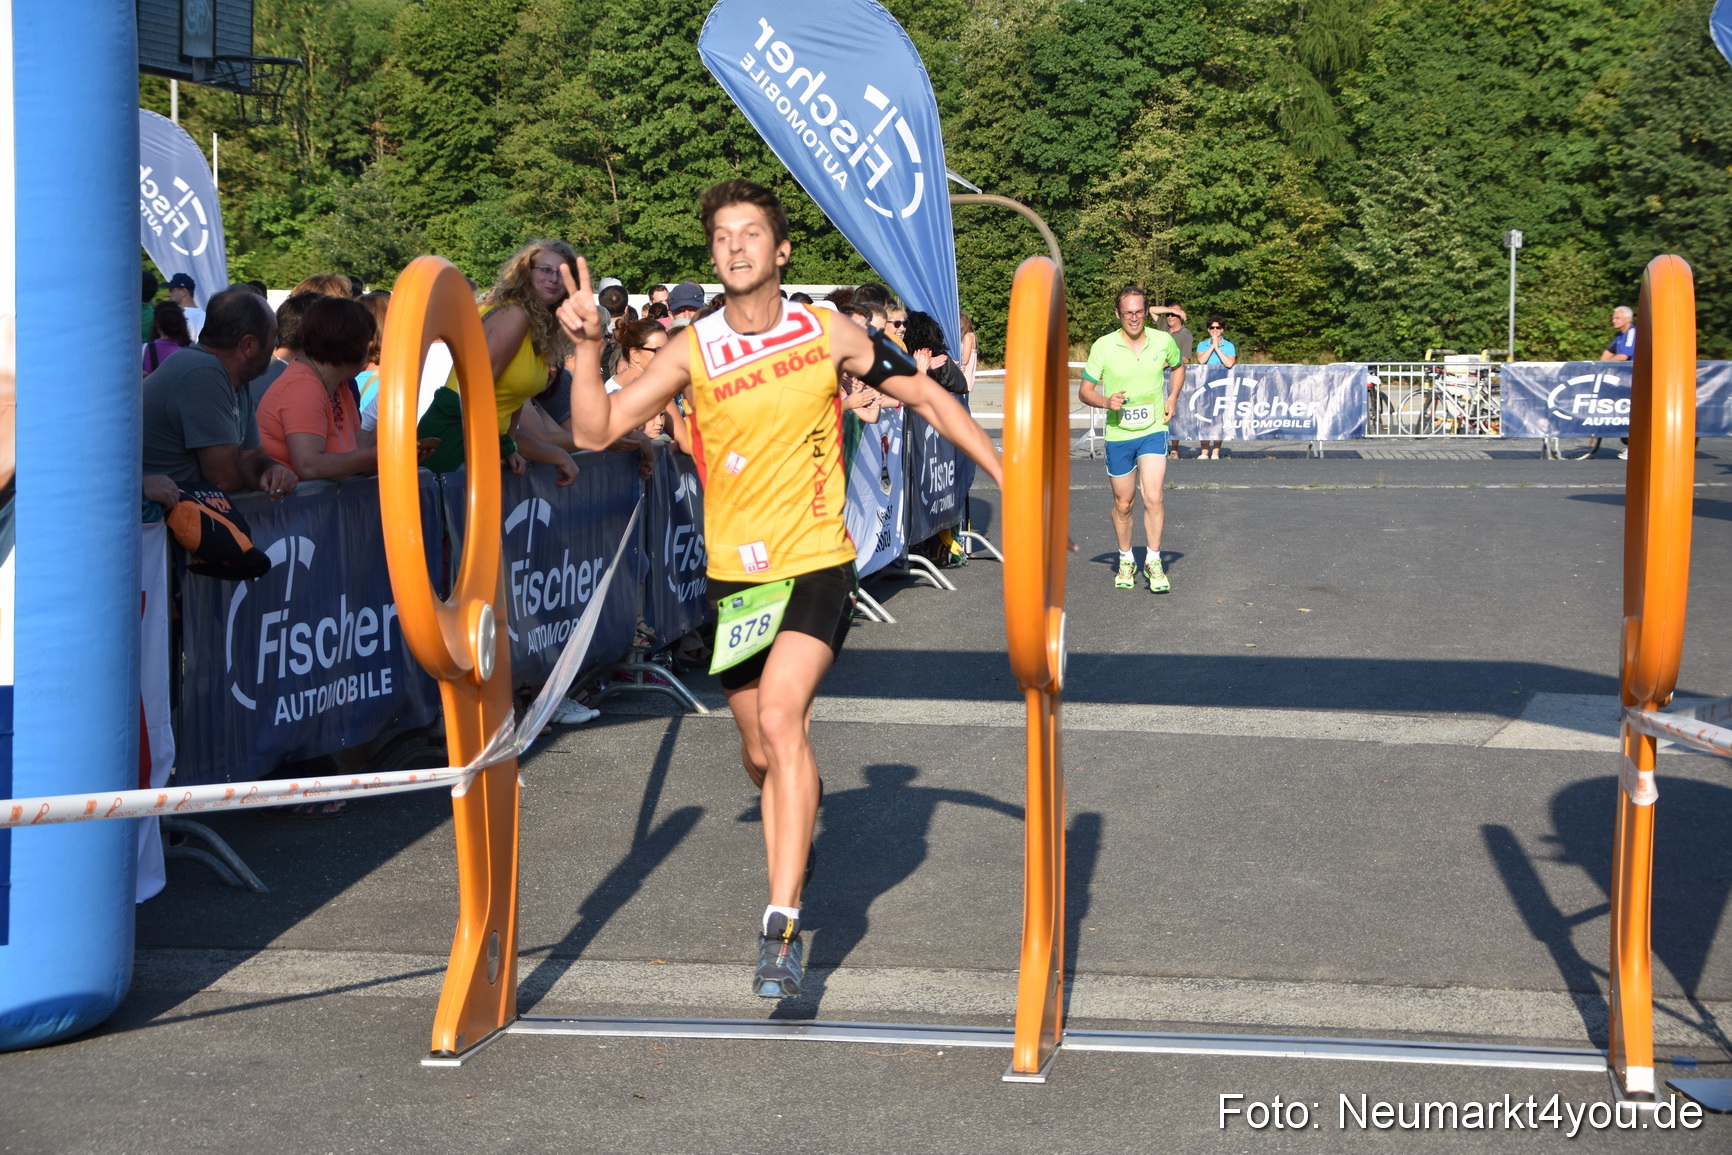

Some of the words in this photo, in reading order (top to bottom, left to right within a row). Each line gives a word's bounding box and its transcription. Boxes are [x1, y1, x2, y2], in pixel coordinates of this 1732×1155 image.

[713, 368, 766, 403] MAX
[772, 345, 831, 379] BÖGL
[1124, 408, 1148, 421] 656
[1212, 396, 1321, 417] Fischer
[1222, 419, 1311, 429] AUTOMOBILE
[673, 523, 707, 575] Fis
[511, 549, 603, 621] Fischer
[257, 594, 398, 684] Fischer
[728, 613, 772, 649] 878
[274, 667, 393, 726] AUTOMOBILE
